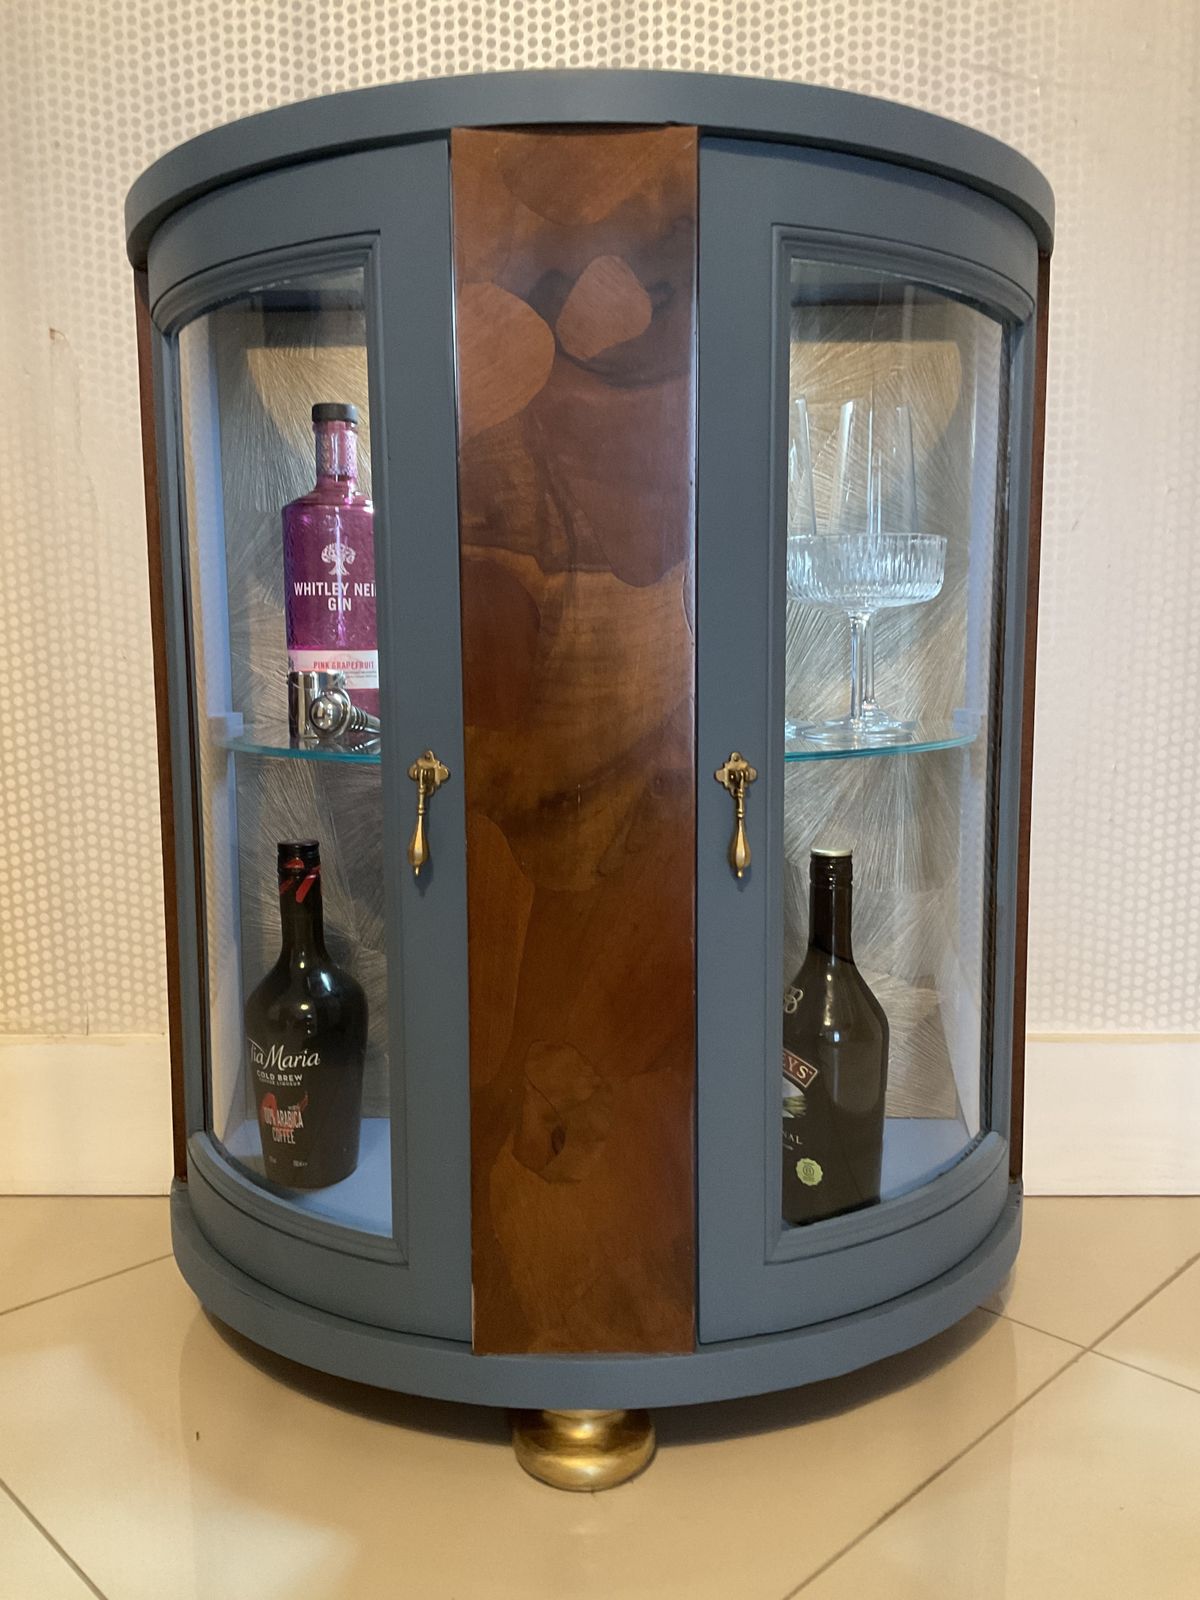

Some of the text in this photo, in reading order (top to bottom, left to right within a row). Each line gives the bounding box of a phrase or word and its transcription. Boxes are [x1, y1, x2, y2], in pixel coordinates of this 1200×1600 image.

[293, 581, 377, 598] WHITLEY NEI
[327, 597, 352, 612] GIN
[313, 661, 374, 670] PINK GRAPEFRUIT
[262, 1044, 320, 1072] Maria
[256, 1069, 275, 1081] COLD
[277, 1074, 303, 1082] BREW
[271, 1126, 296, 1145] COFFEE
